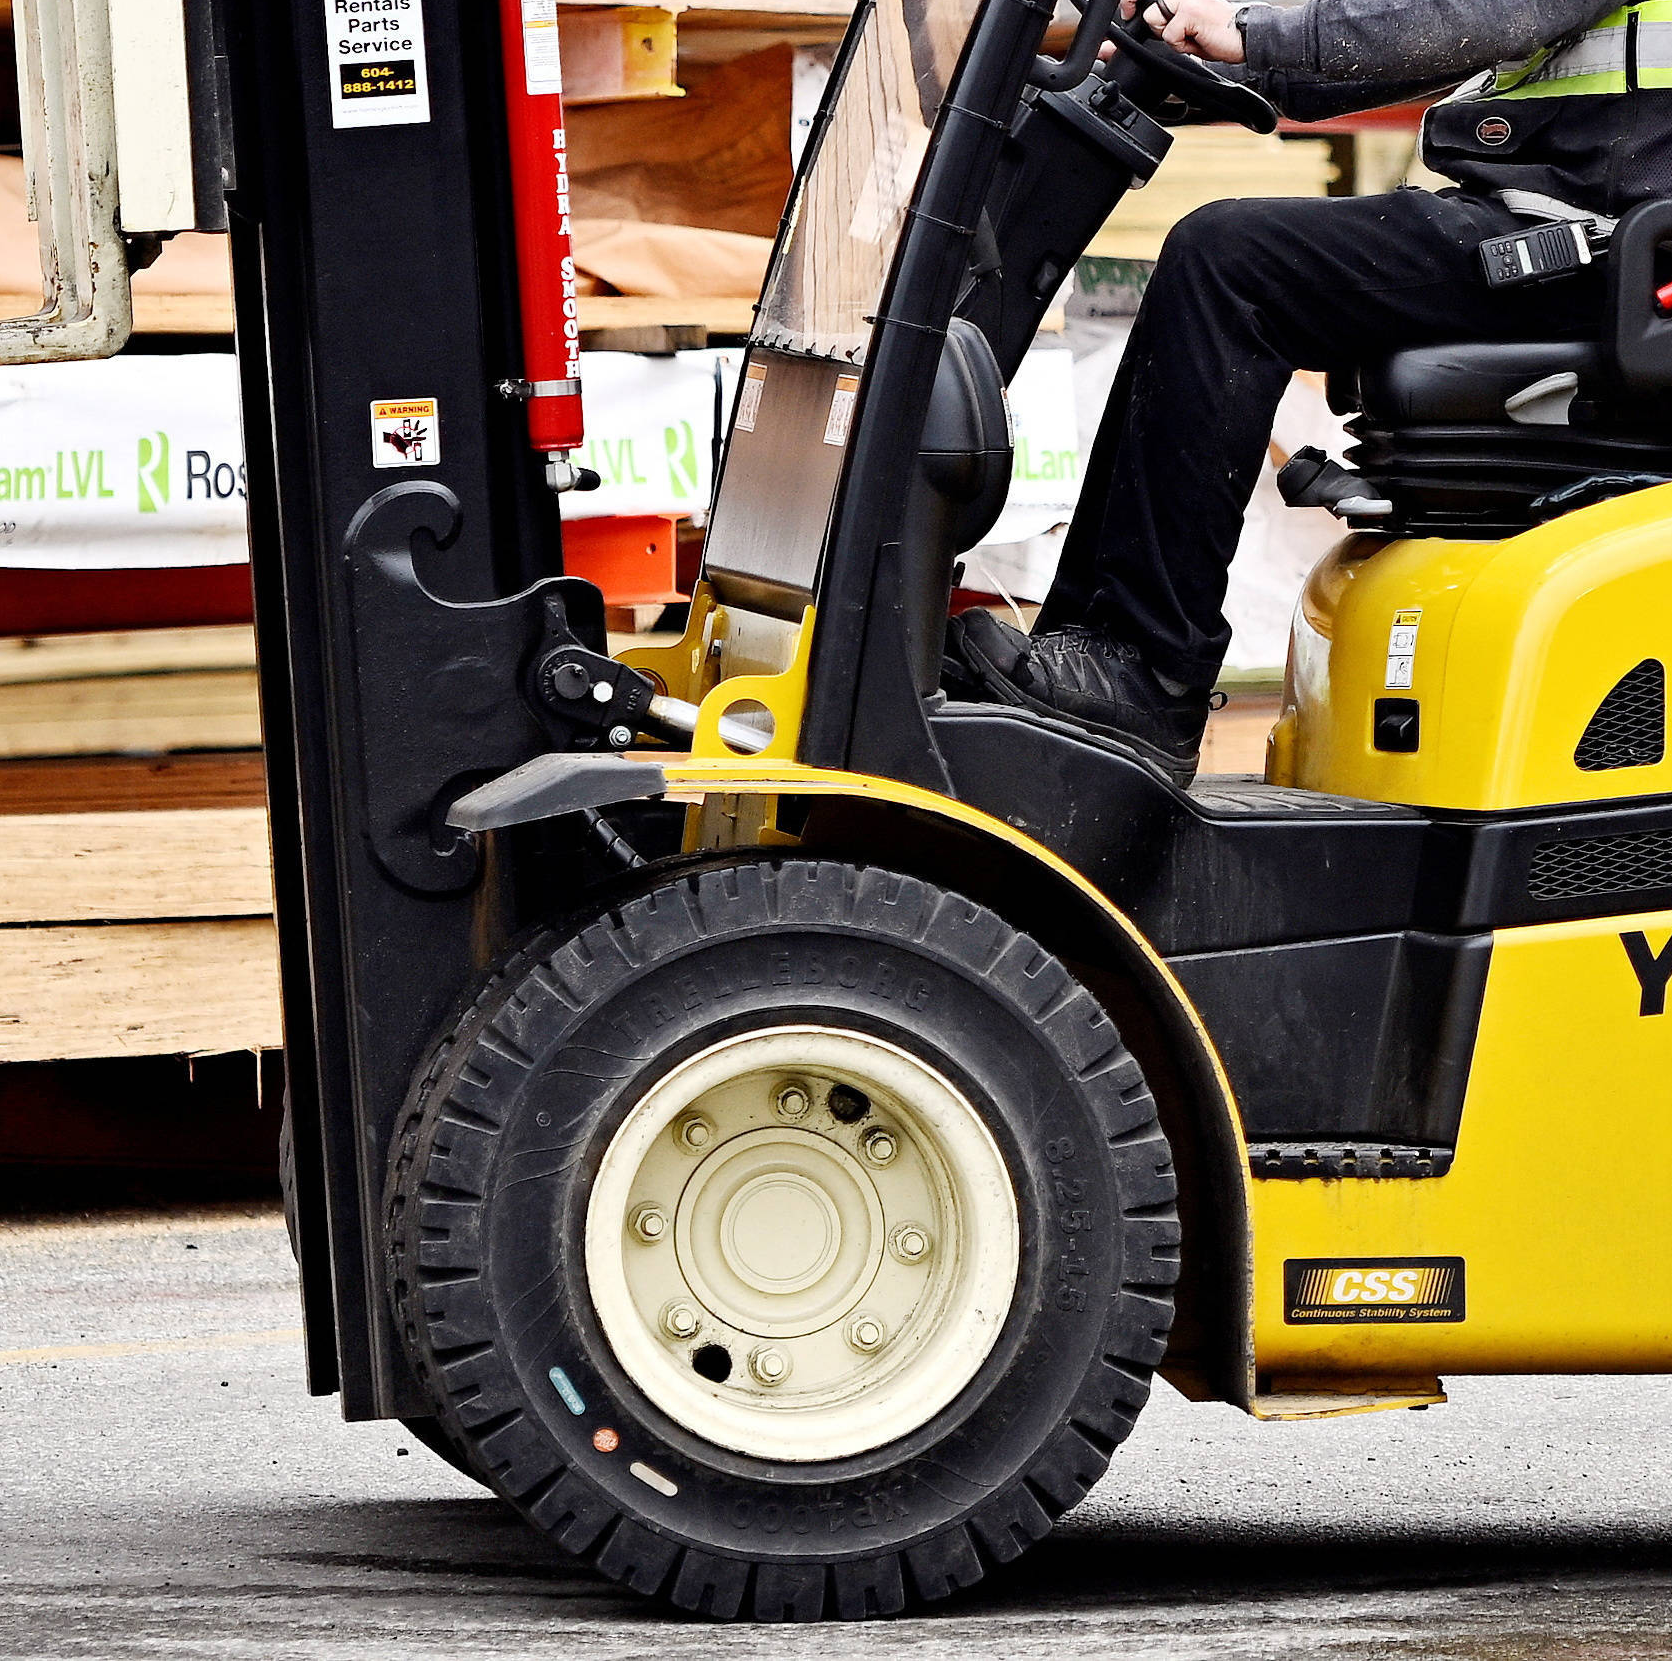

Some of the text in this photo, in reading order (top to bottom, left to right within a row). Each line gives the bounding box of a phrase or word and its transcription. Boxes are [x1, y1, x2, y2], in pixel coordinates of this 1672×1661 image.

[348, 17, 400, 33] Parts
[339, 36, 413, 55] Service
[361, 67, 394, 79] 604-
[342, 79, 415, 94] 888-1412
[552, 129, 581, 380] HYDRA SMOOTH
[389, 404, 430, 415] WARNING
[56, 450, 115, 499] LVL
[612, 948, 933, 1048] TRELLEBORG
[1332, 1270, 1419, 1302] CSS
[1291, 1307, 1452, 1320] Continuous Stability System
